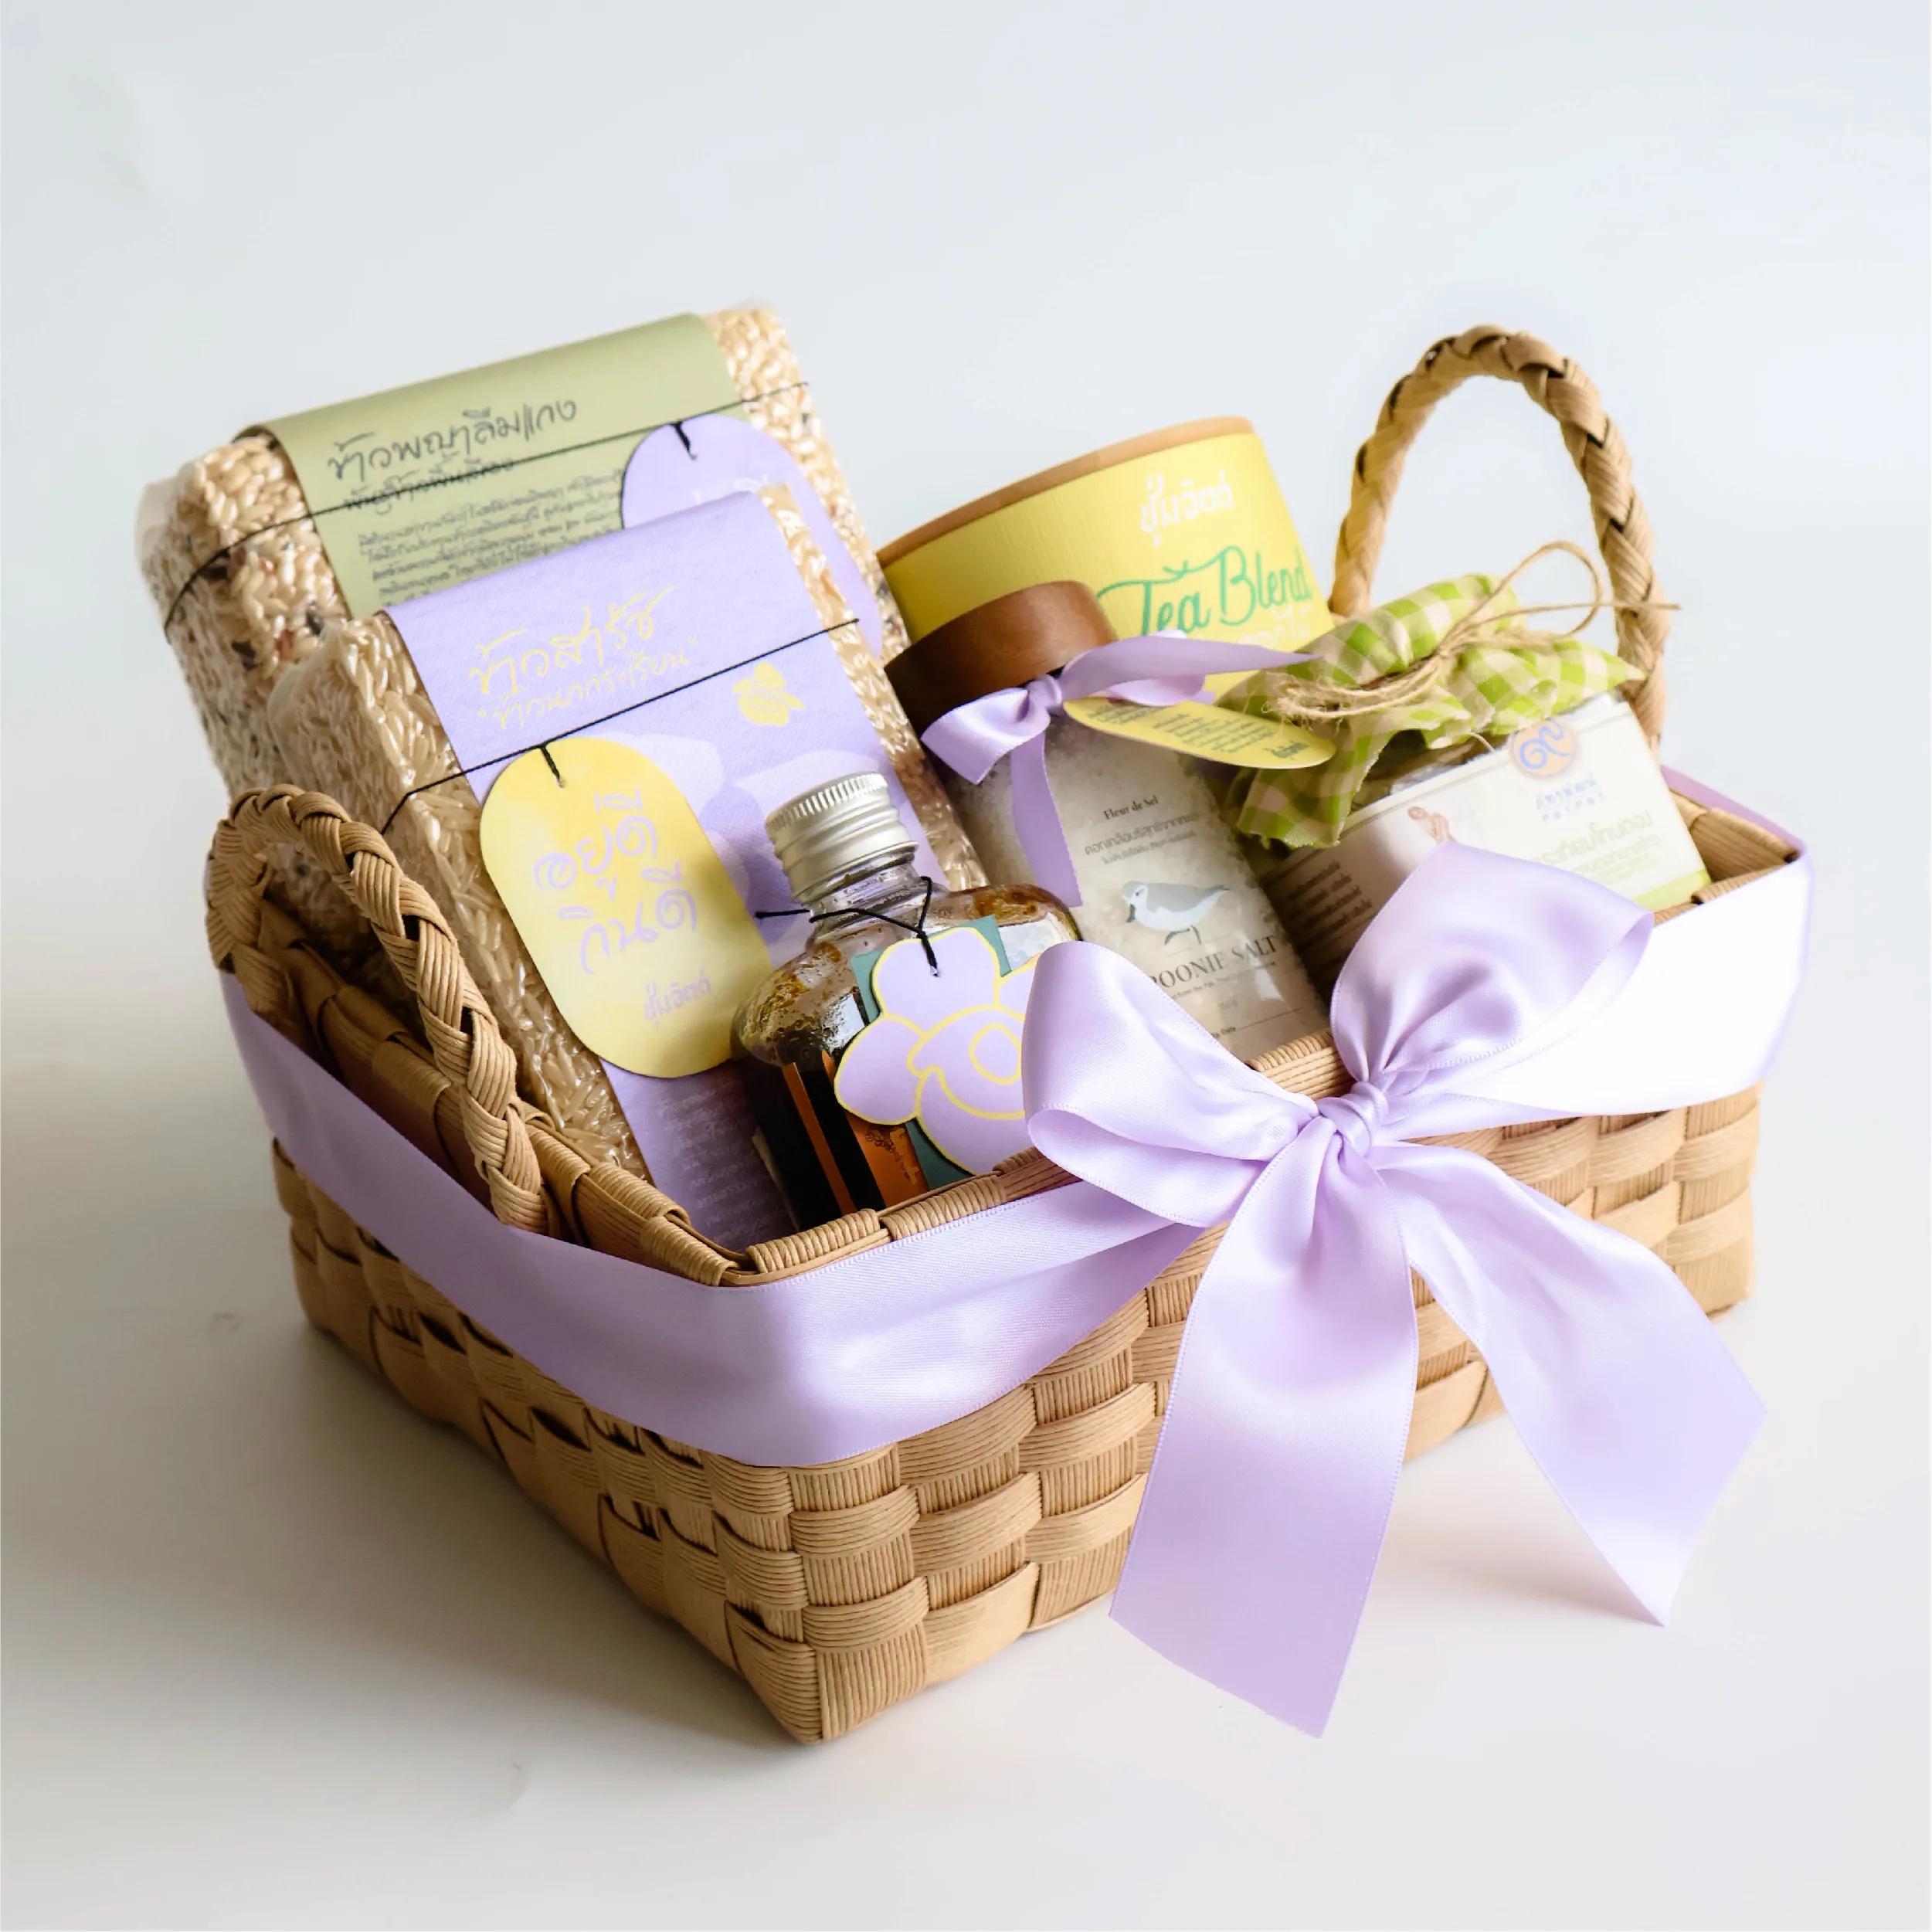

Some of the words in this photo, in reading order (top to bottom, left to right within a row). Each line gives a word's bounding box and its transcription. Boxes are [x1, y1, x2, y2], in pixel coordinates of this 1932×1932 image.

[1097, 561, 1212, 637] Tea
[1193, 545, 1312, 626] Blend
[1103, 803, 1129, 820] Fleur
[1132, 800, 1143, 812] de
[1149, 952, 1224, 989] OONIE
[1231, 934, 1278, 963] SALT
